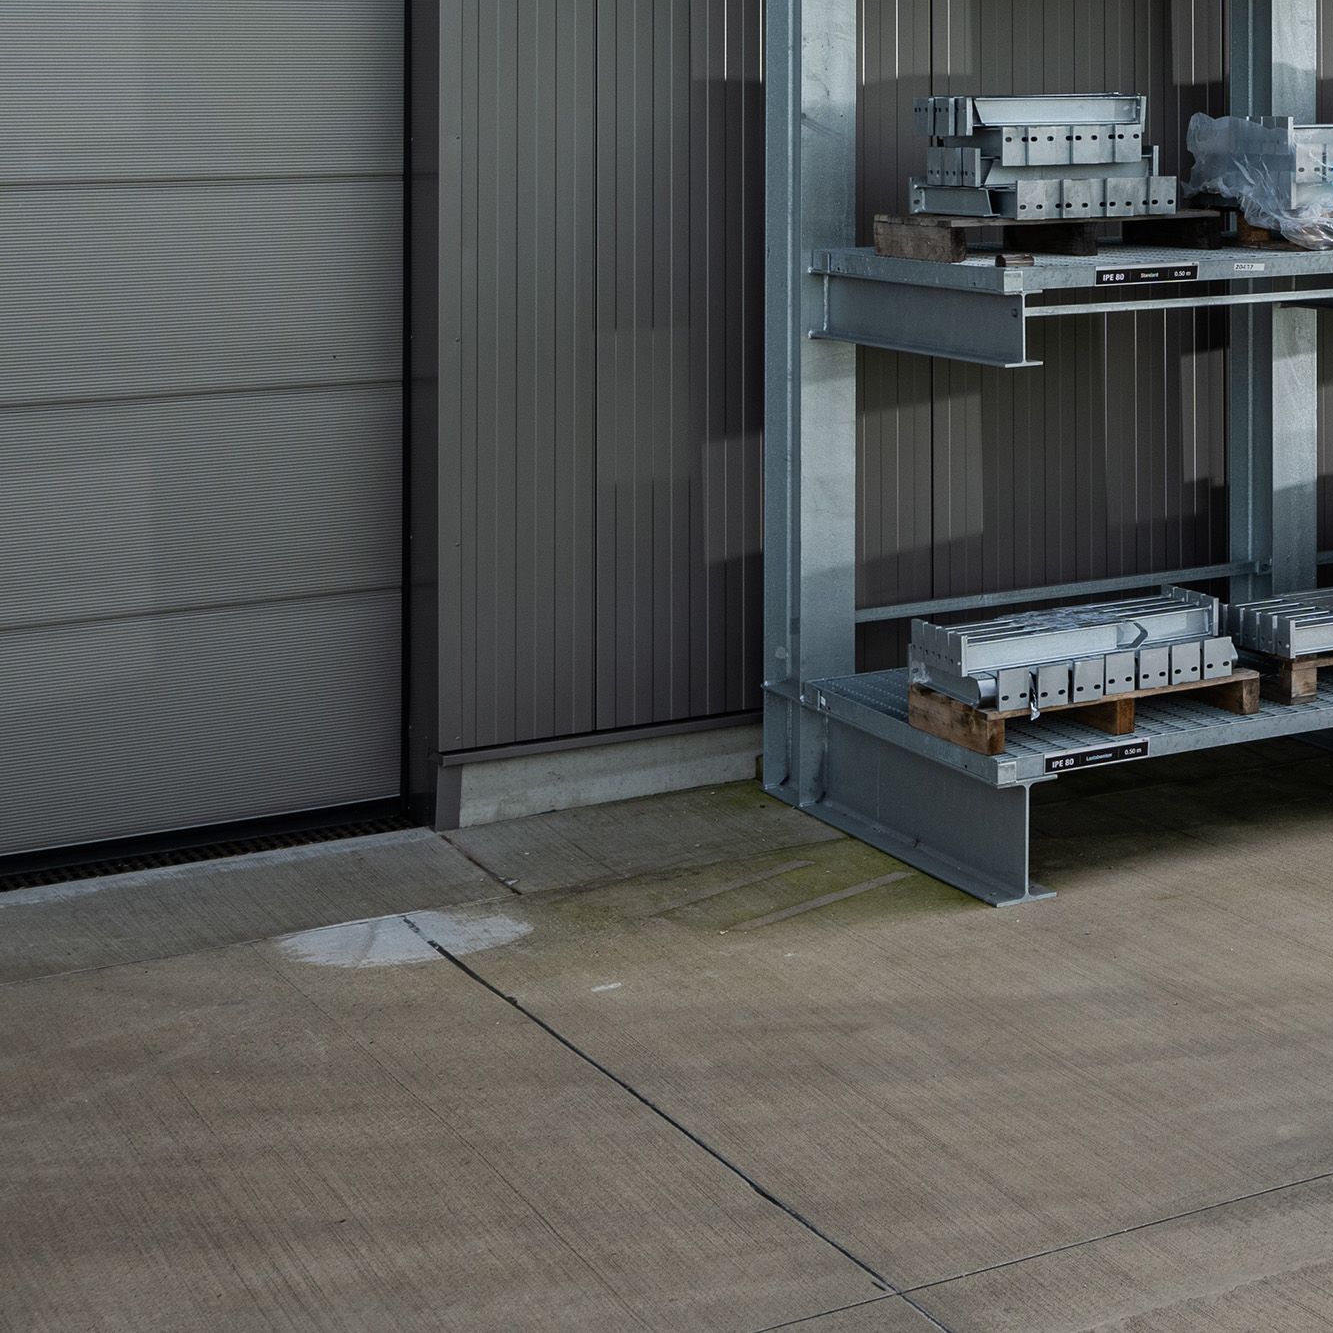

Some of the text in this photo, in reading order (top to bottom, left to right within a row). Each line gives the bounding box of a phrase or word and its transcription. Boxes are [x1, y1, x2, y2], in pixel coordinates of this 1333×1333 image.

[1102, 273, 1114, 282] IPE
[1115, 273, 1125, 281] 80
[1052, 759, 1064, 769] IPE
[1064, 758, 1075, 766] 80
